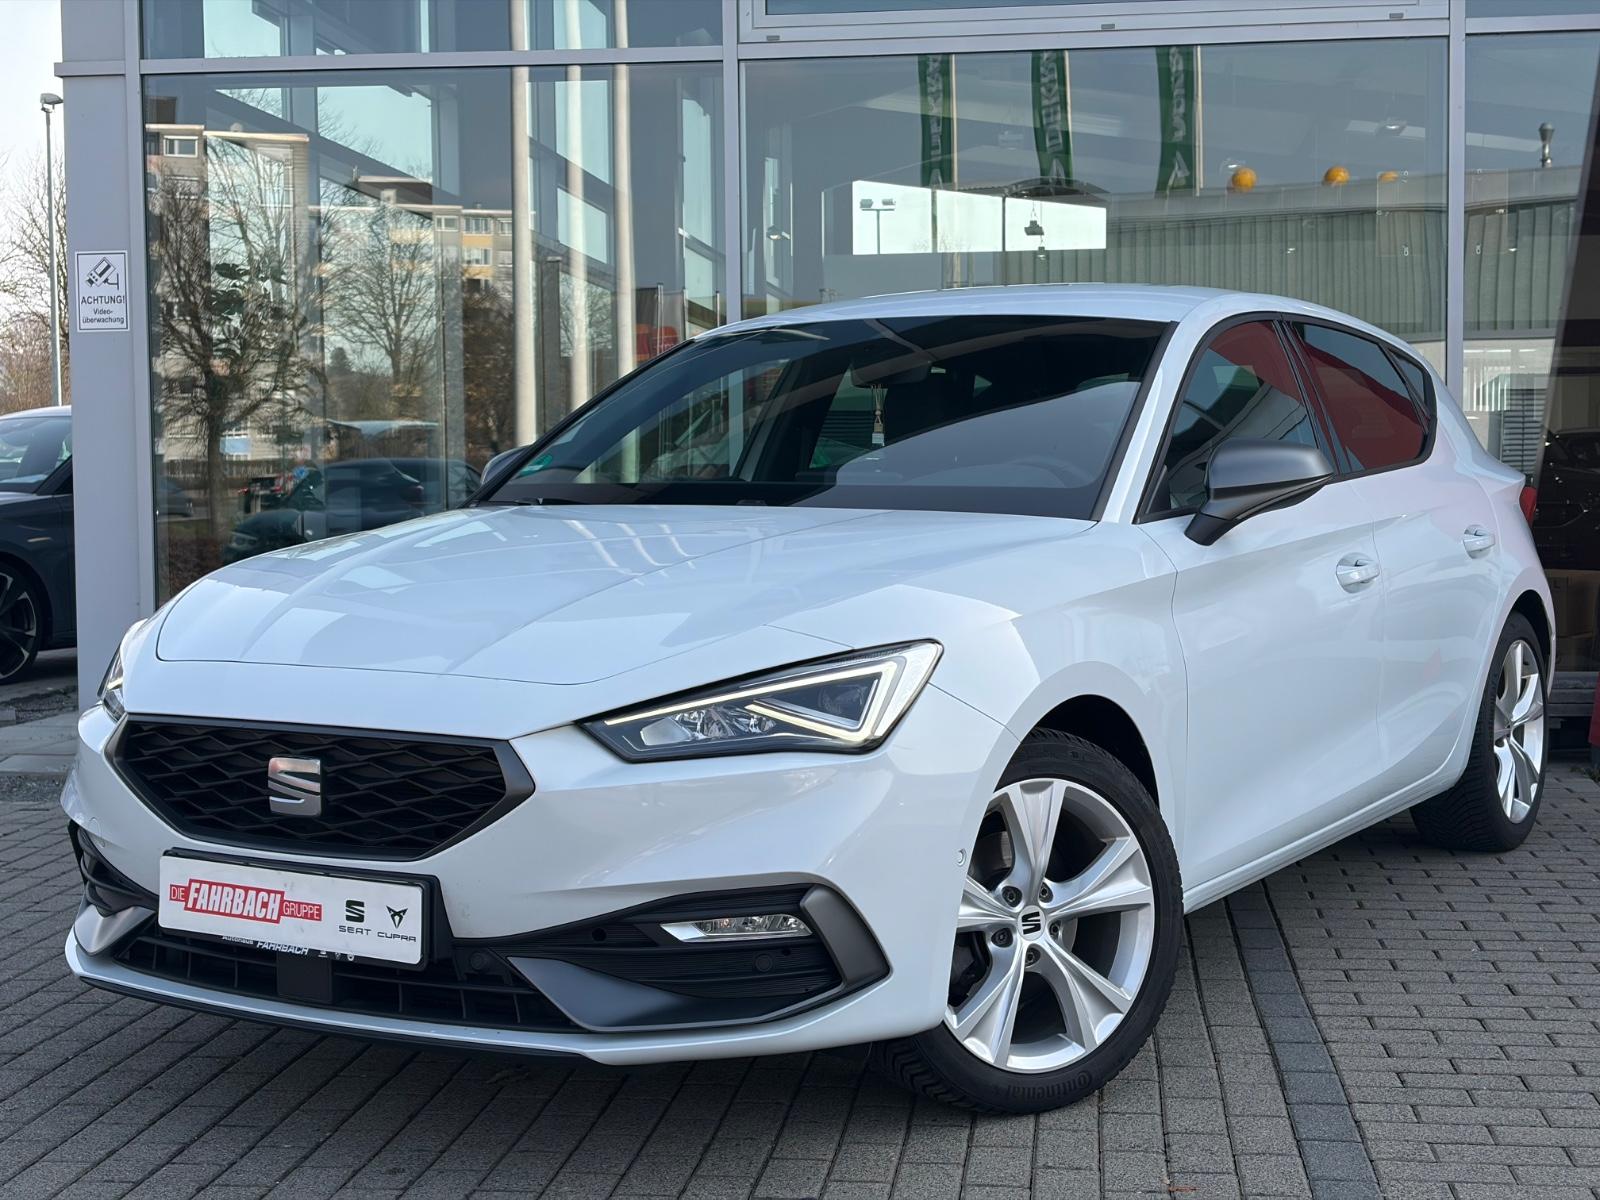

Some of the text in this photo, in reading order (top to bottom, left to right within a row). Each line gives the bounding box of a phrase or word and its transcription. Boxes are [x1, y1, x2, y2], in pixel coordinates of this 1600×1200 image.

[81, 295, 125, 305] ACHTUNG!
[82, 316, 125, 325] überwachung
[171, 882, 320, 921] DIE FAHRBACH GRUPPE
[338, 925, 372, 936] SEAT
[377, 931, 417, 943] CUPRA
